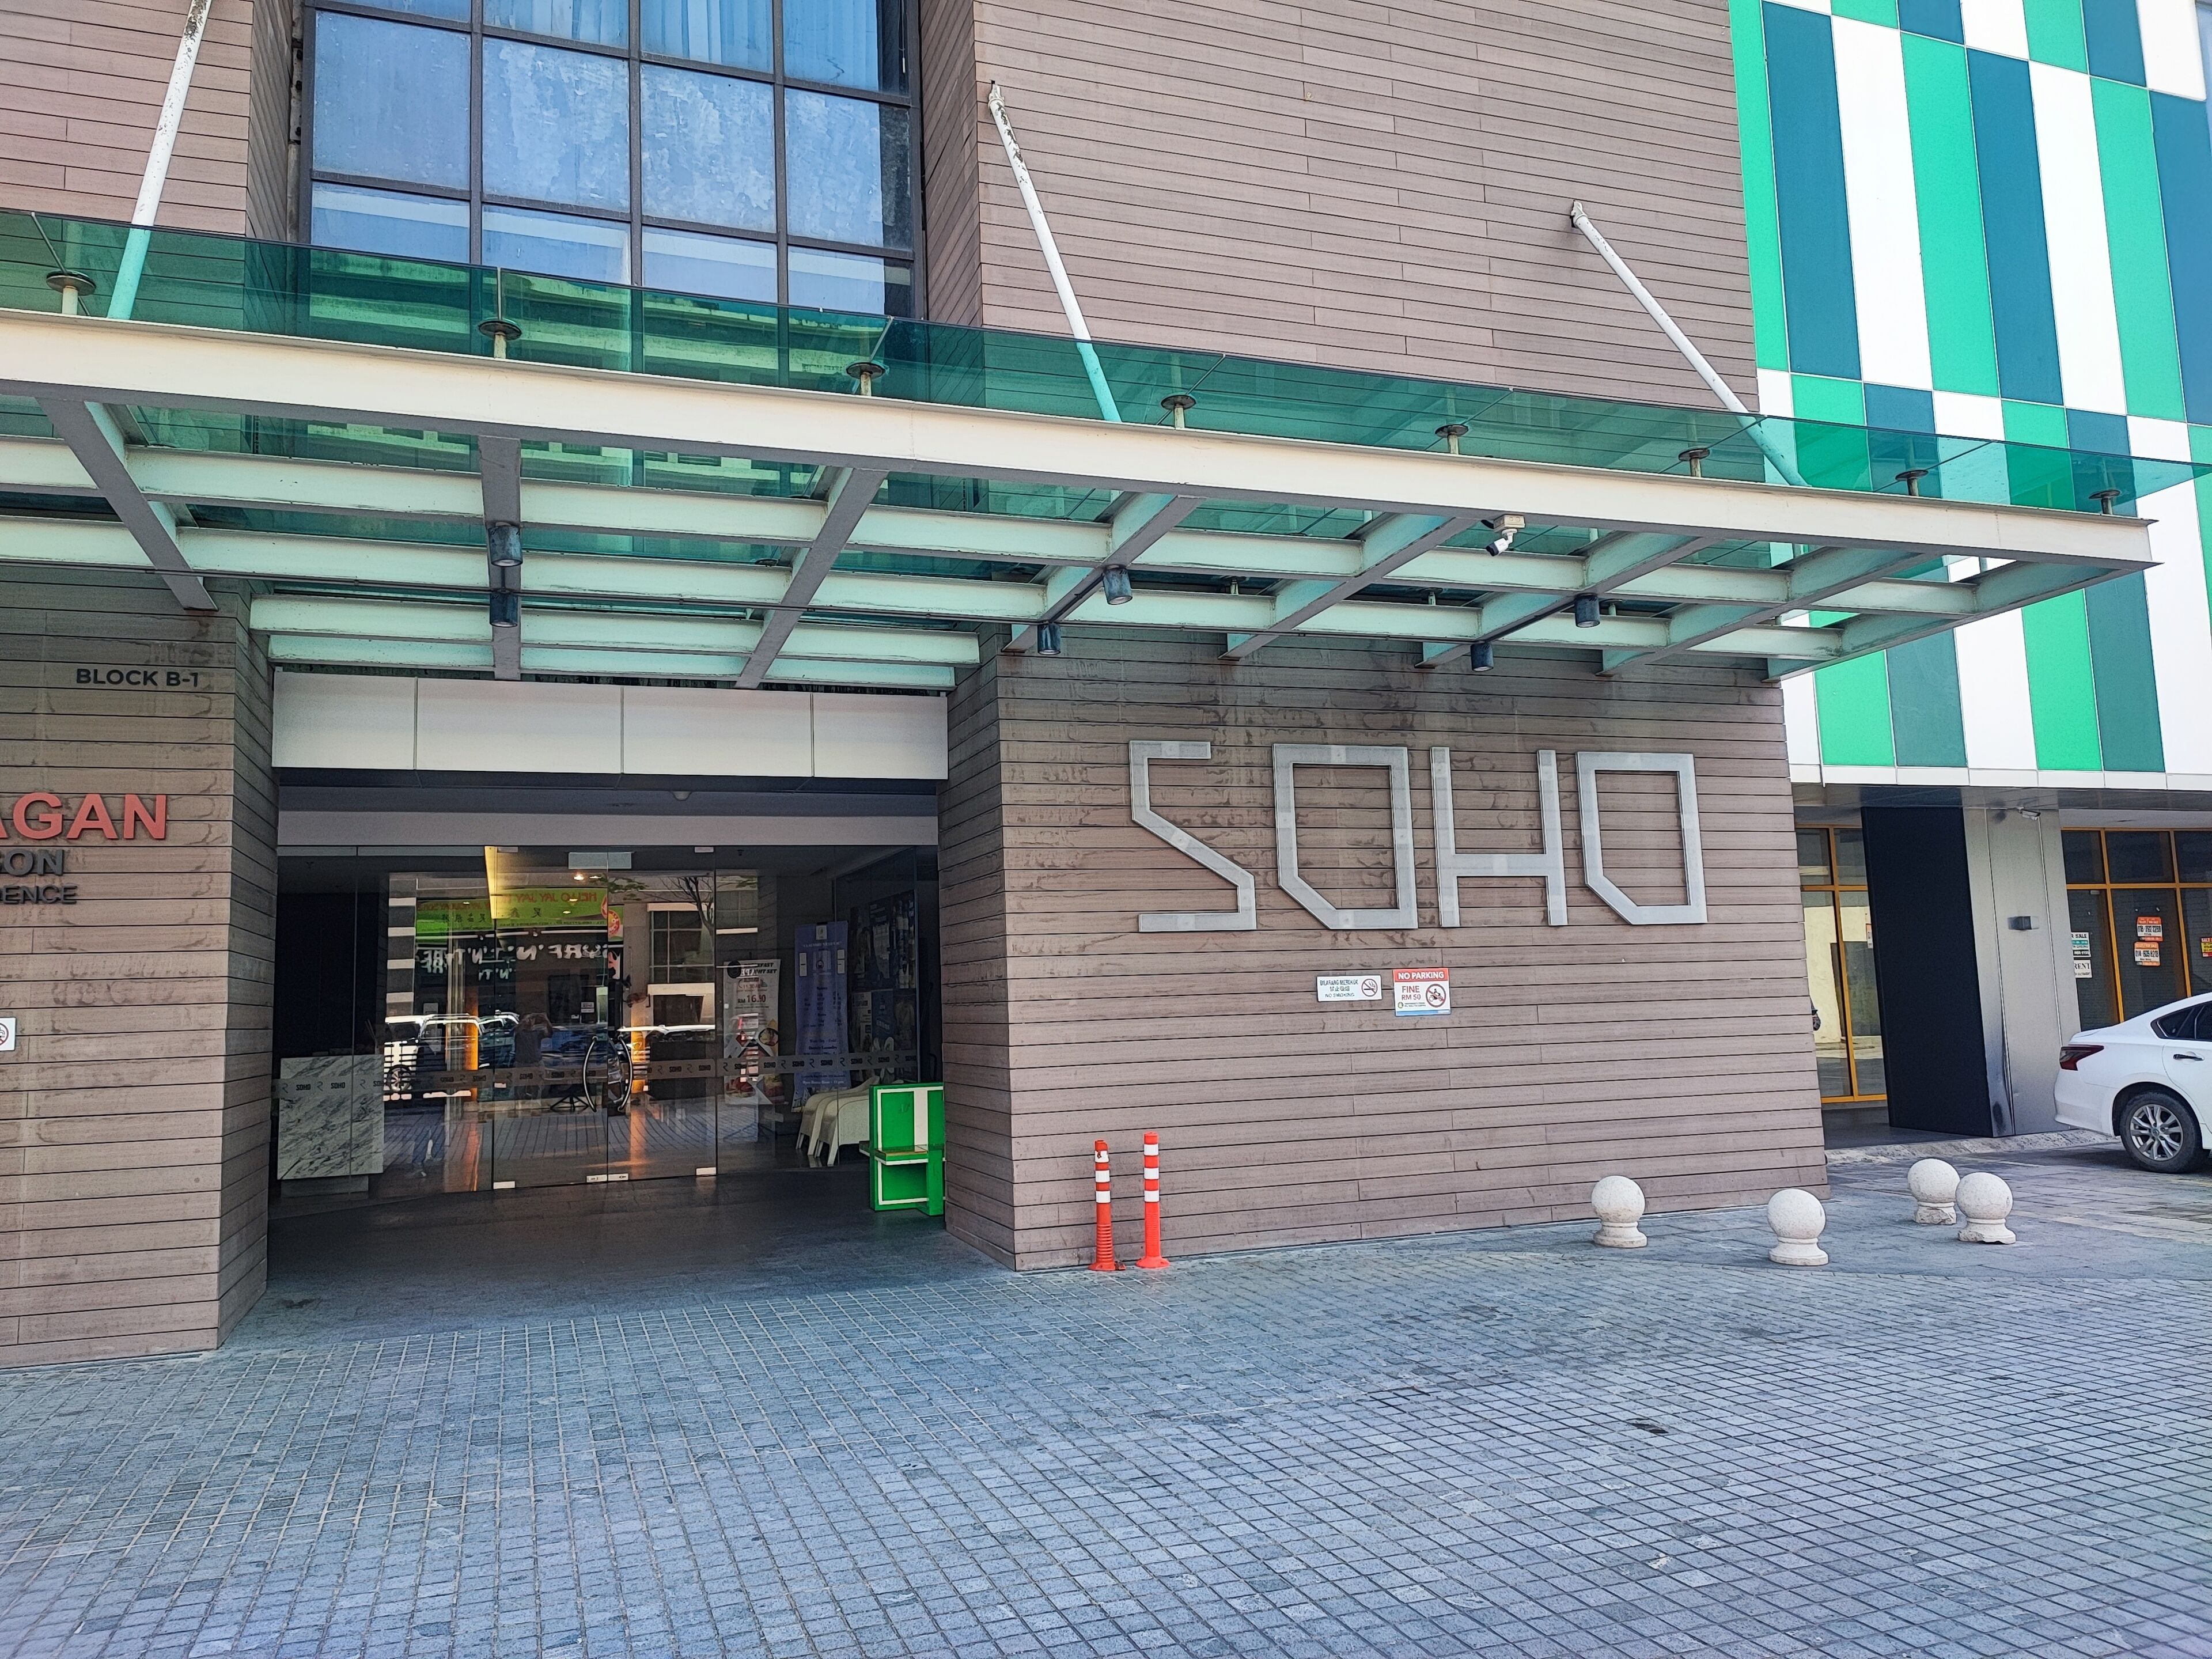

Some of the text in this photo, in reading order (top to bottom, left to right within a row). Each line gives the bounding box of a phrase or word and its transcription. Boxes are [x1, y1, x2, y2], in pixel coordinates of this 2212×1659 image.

[76, 669, 198, 687] BLOCK B-1
[1129, 741, 1708, 932] SOHO
[0, 849, 65, 876] ON
[0, 885, 78, 904] ENCE
[1402, 985, 1421, 993] FINE
